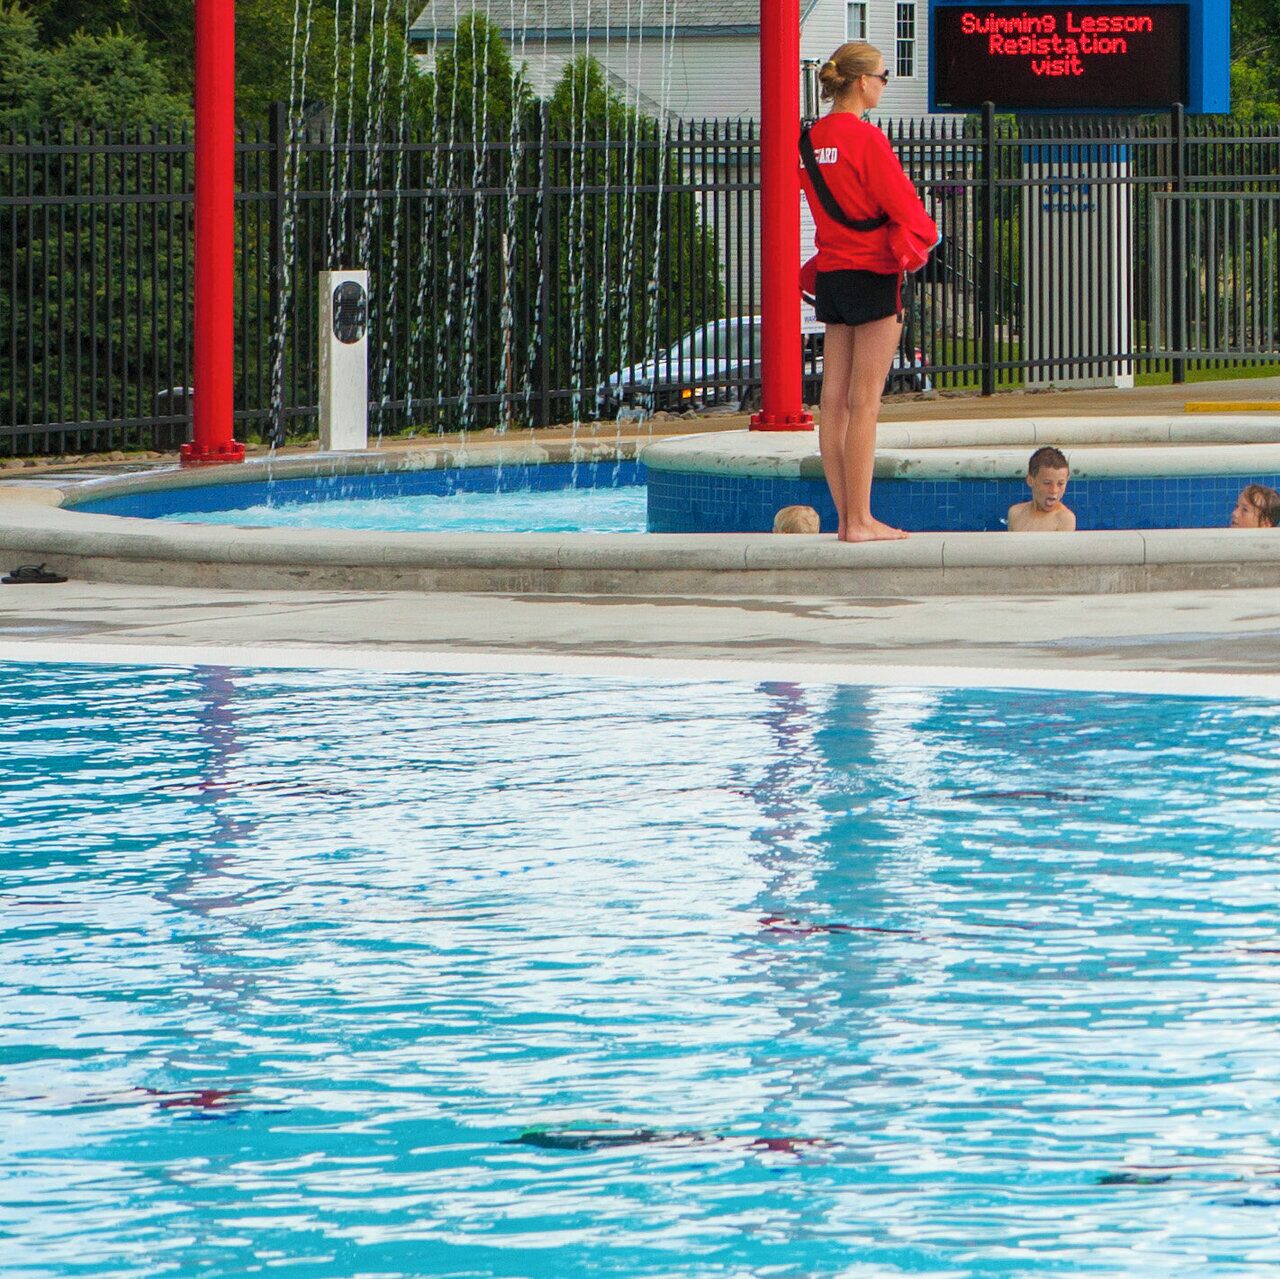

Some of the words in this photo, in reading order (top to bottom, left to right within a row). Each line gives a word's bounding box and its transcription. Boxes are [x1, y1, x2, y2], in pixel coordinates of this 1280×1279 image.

[961, 11, 1056, 34] Swimming
[1067, 11, 1153, 33] Lesson
[1031, 54, 1084, 76] visit
